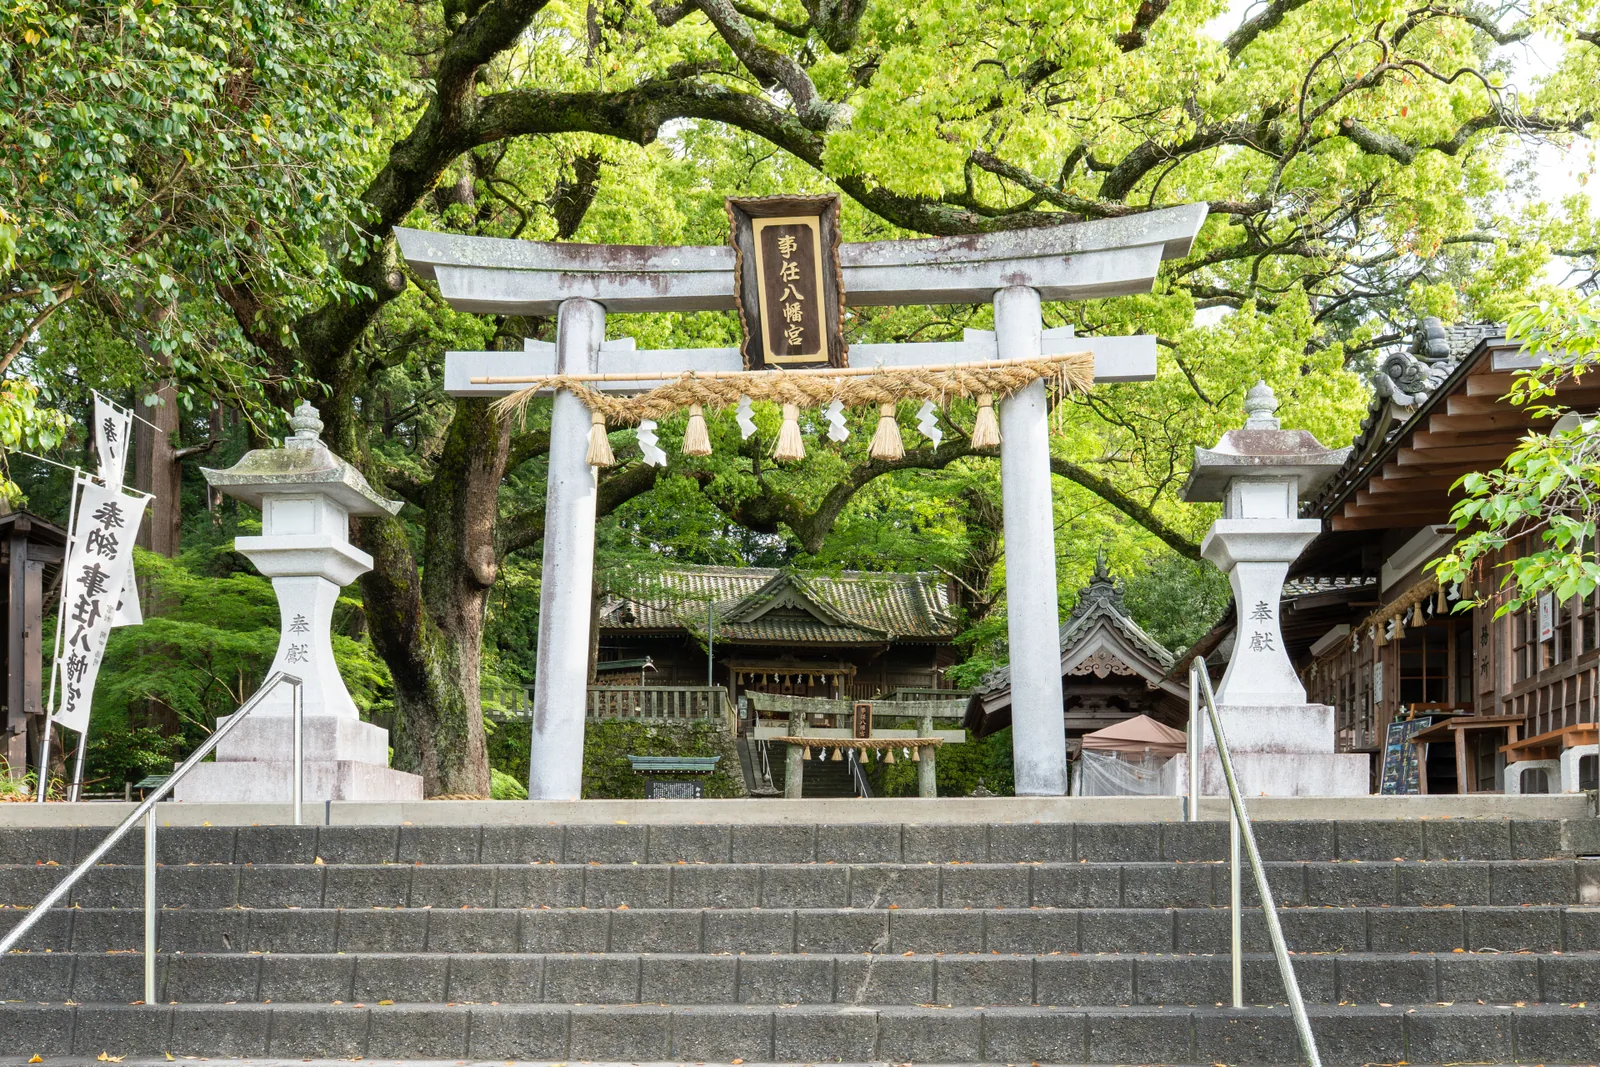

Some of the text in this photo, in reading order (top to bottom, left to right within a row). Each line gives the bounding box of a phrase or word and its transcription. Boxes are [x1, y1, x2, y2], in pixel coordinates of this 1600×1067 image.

[777, 234, 805, 346] 事任八幡宮
